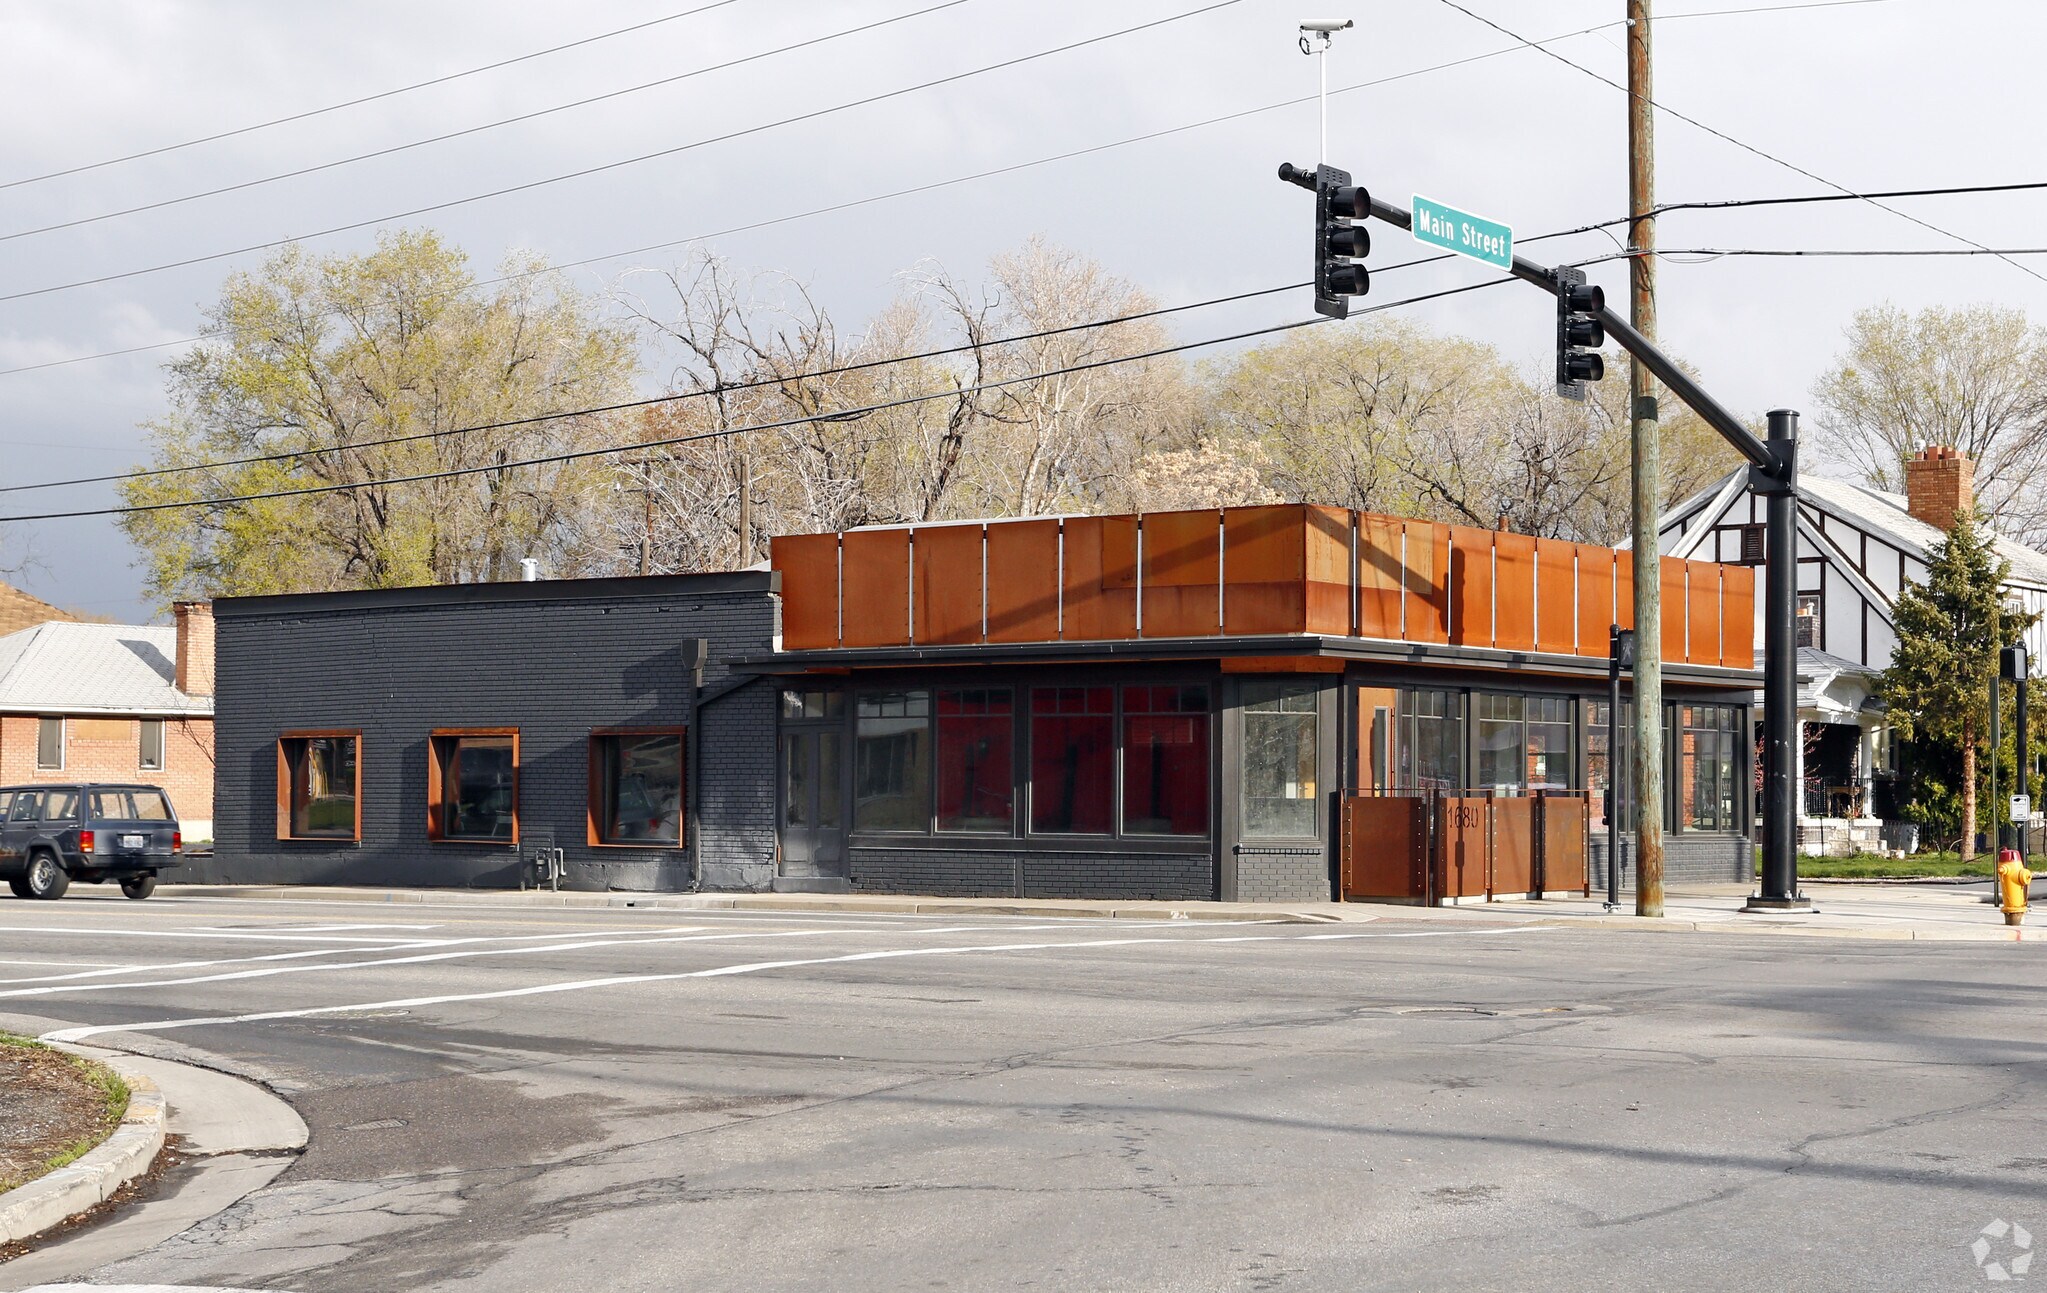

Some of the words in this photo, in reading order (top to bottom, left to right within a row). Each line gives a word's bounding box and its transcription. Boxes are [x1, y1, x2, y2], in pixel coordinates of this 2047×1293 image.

[1419, 208, 1454, 241] Main
[1462, 222, 1505, 257] Street
[1448, 805, 1478, 829] 1680
